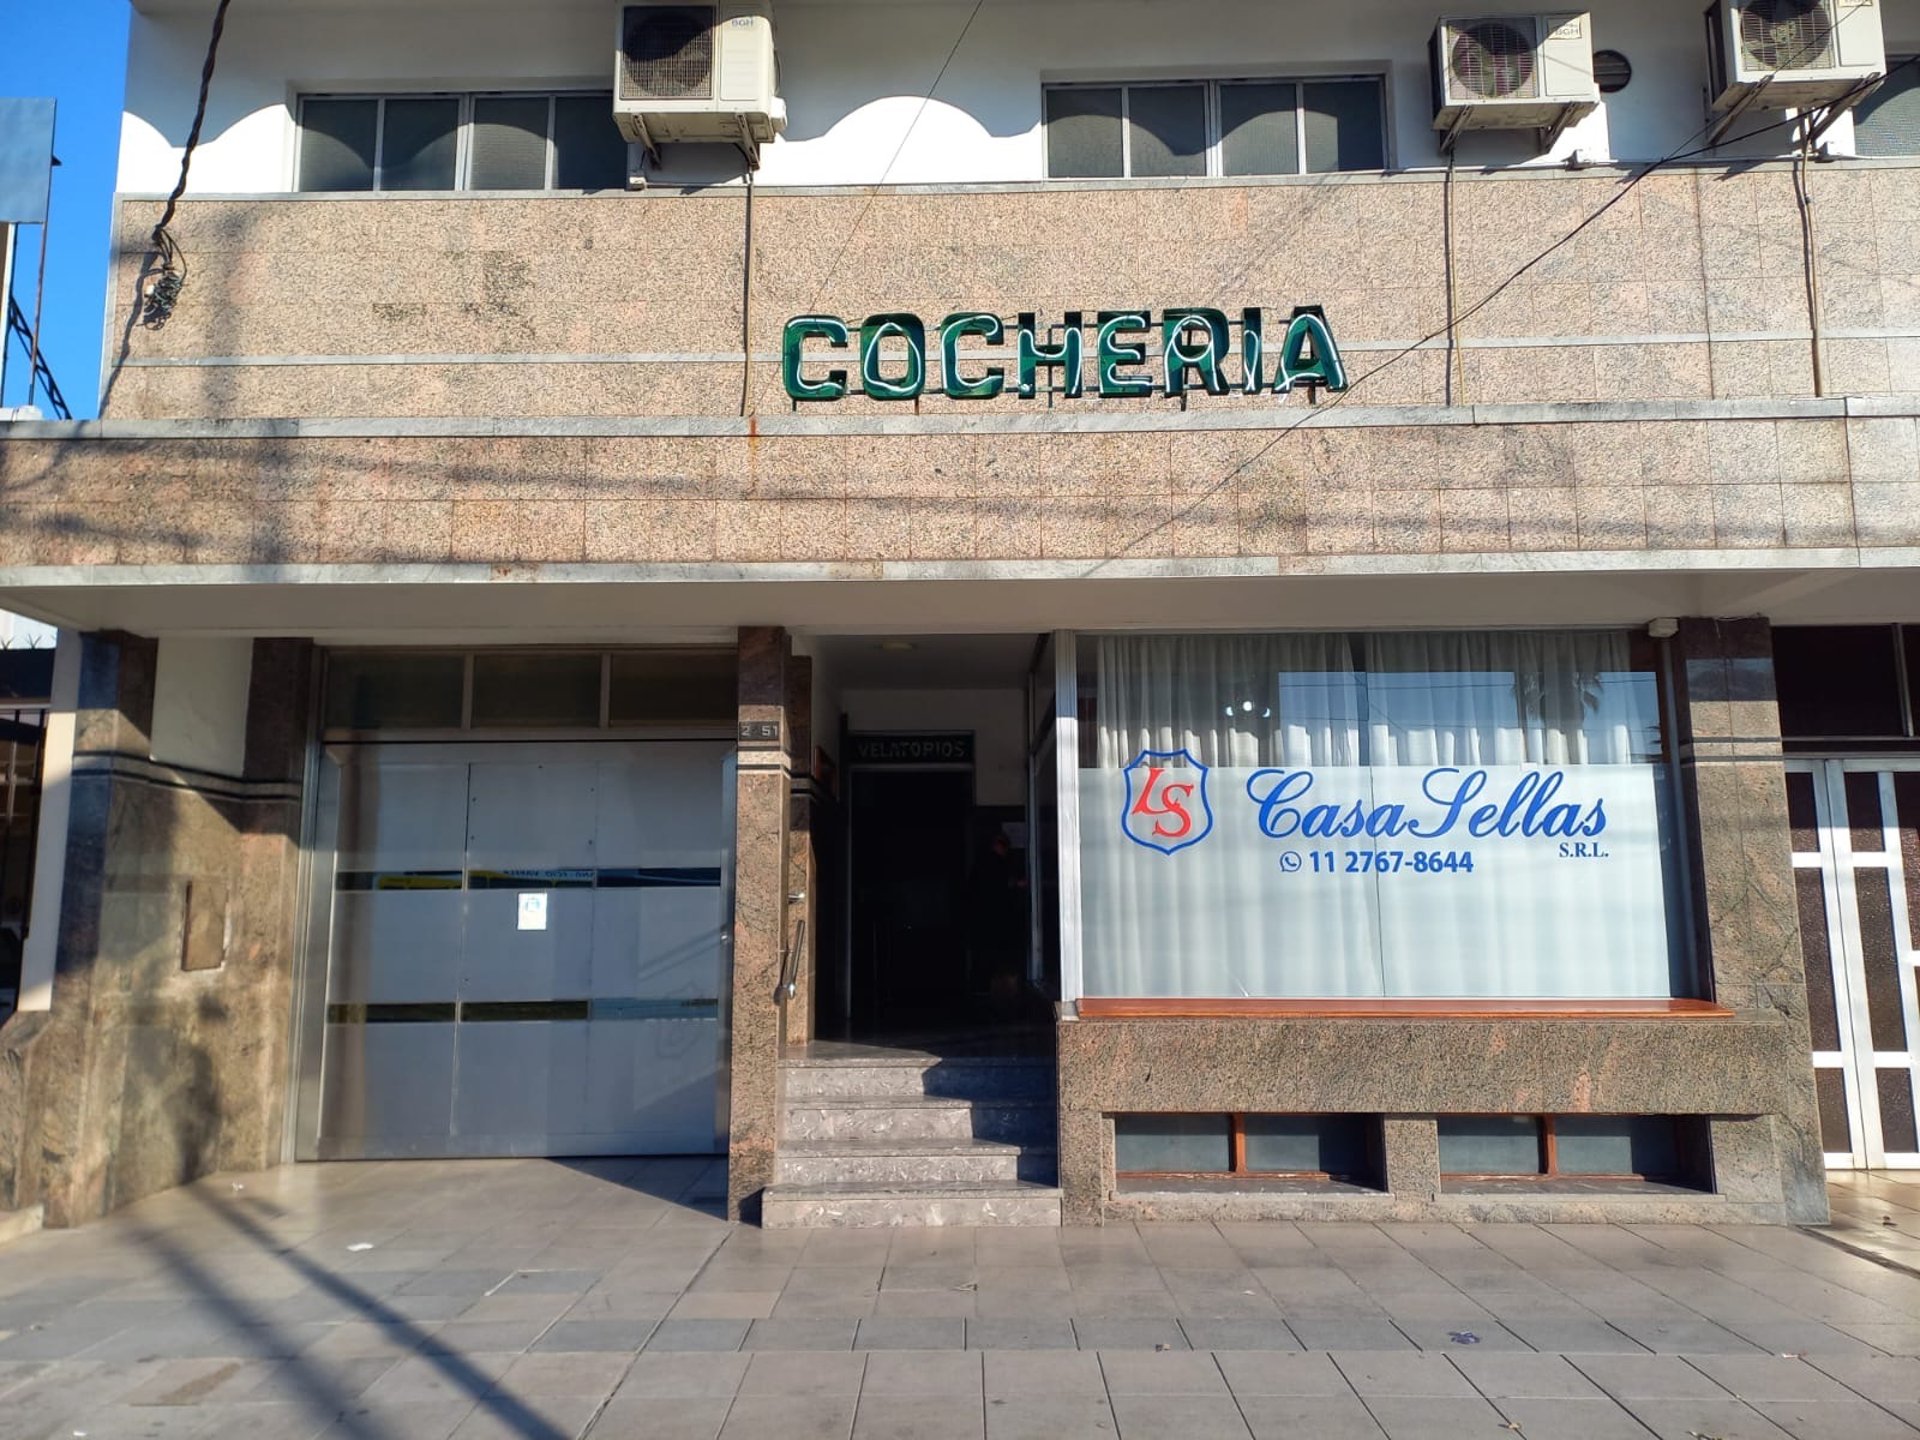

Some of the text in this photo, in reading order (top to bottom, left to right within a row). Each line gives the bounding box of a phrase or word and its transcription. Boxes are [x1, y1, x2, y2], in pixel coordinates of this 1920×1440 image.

[782, 305, 1348, 400] COCHERIA
[857, 739, 965, 758] VELATORIOS
[1247, 767, 1607, 838] Casa Sellas
[1309, 850, 1475, 873] 11 2767-8644
[1559, 842, 1609, 858] S.R.L.
